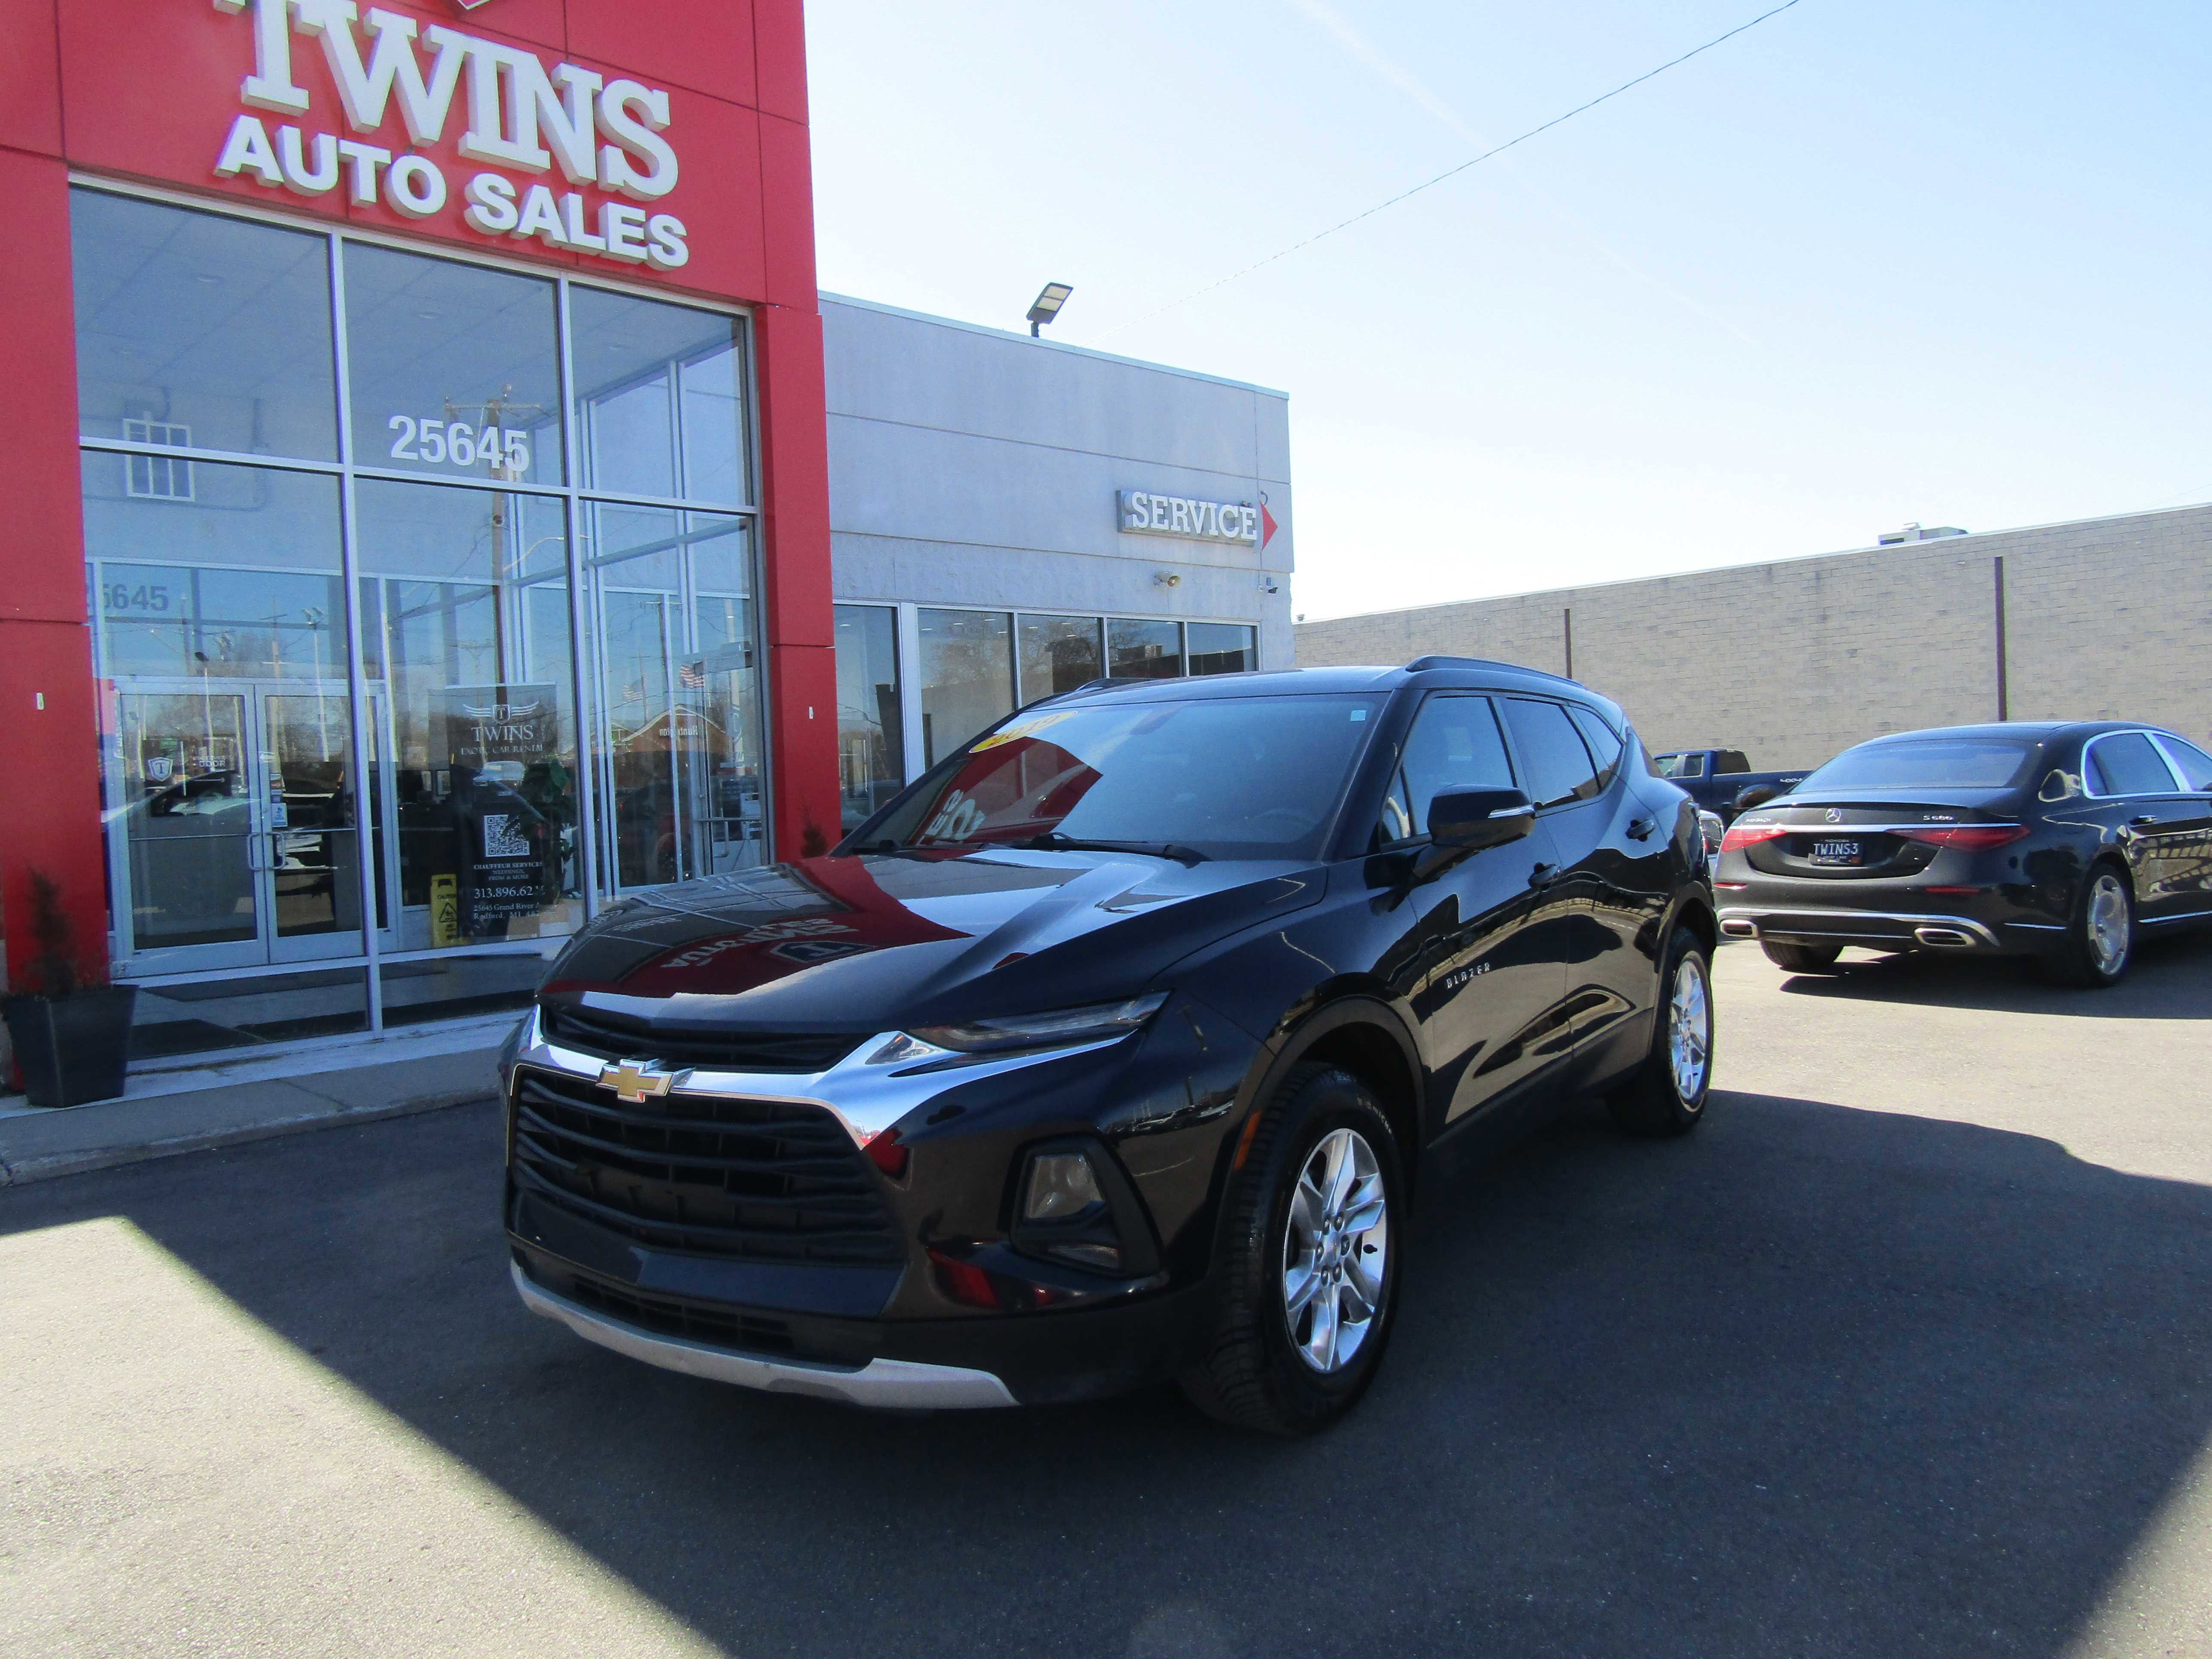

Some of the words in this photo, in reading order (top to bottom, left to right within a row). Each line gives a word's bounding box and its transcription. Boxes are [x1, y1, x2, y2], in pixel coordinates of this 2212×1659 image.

[213, 0, 679, 202] TWINS
[213, 114, 447, 219] AUTO
[463, 172, 690, 271] SALES
[389, 415, 529, 472] 25645
[1129, 491, 1258, 541] SERVICE
[471, 725, 533, 742] TWINS
[987, 714, 1061, 747] 2019
[1813, 843, 1859, 855] TWINS3
[1446, 962, 1490, 989] BLAZER
